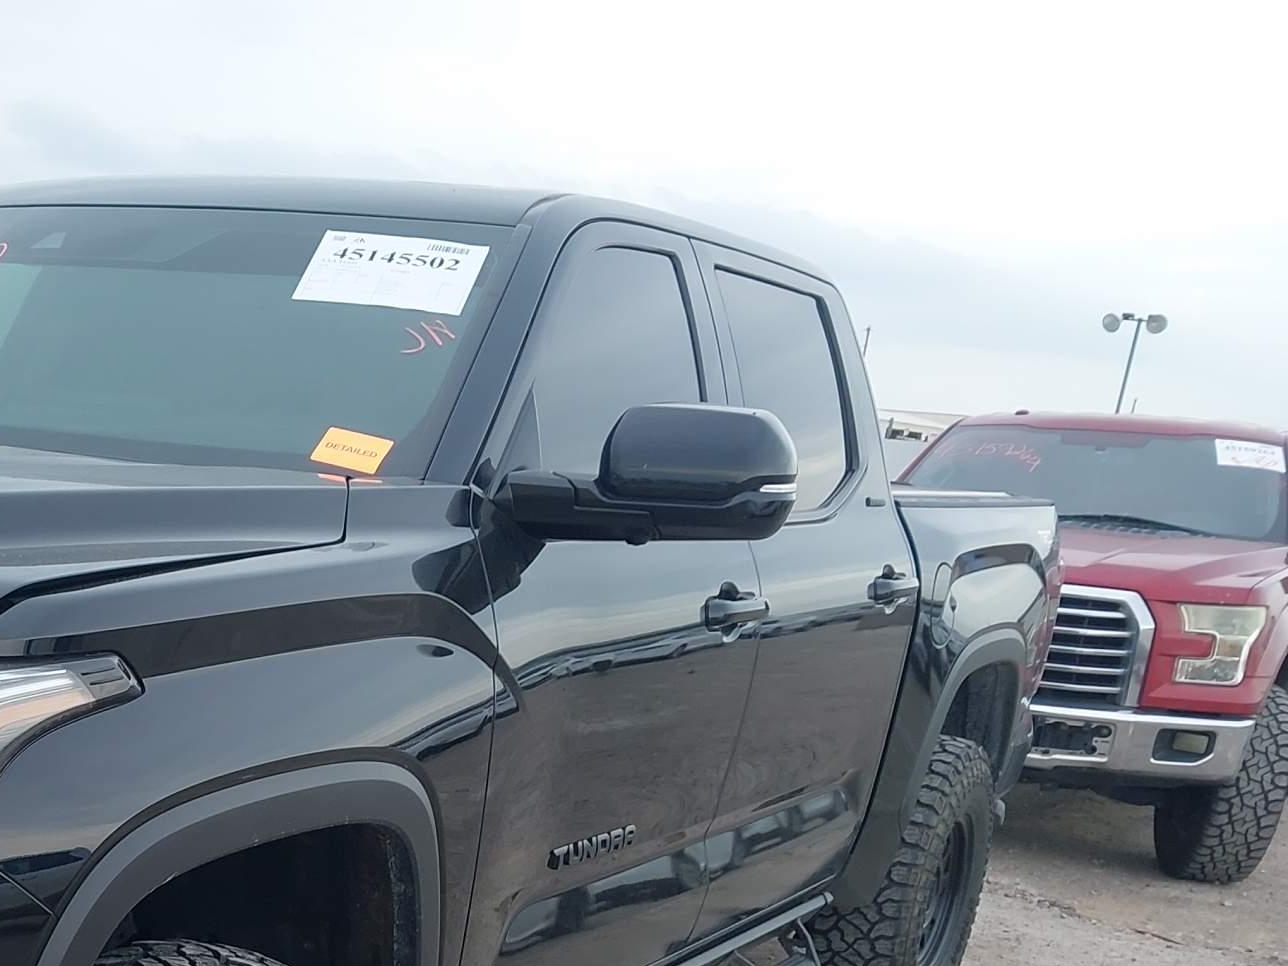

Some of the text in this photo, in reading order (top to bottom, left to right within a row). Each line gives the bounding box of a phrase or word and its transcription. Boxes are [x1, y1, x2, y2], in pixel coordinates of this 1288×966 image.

[333, 246, 461, 271] 45145502
[324, 440, 379, 459] DETAILED
[547, 823, 637, 870] TUNDRA
